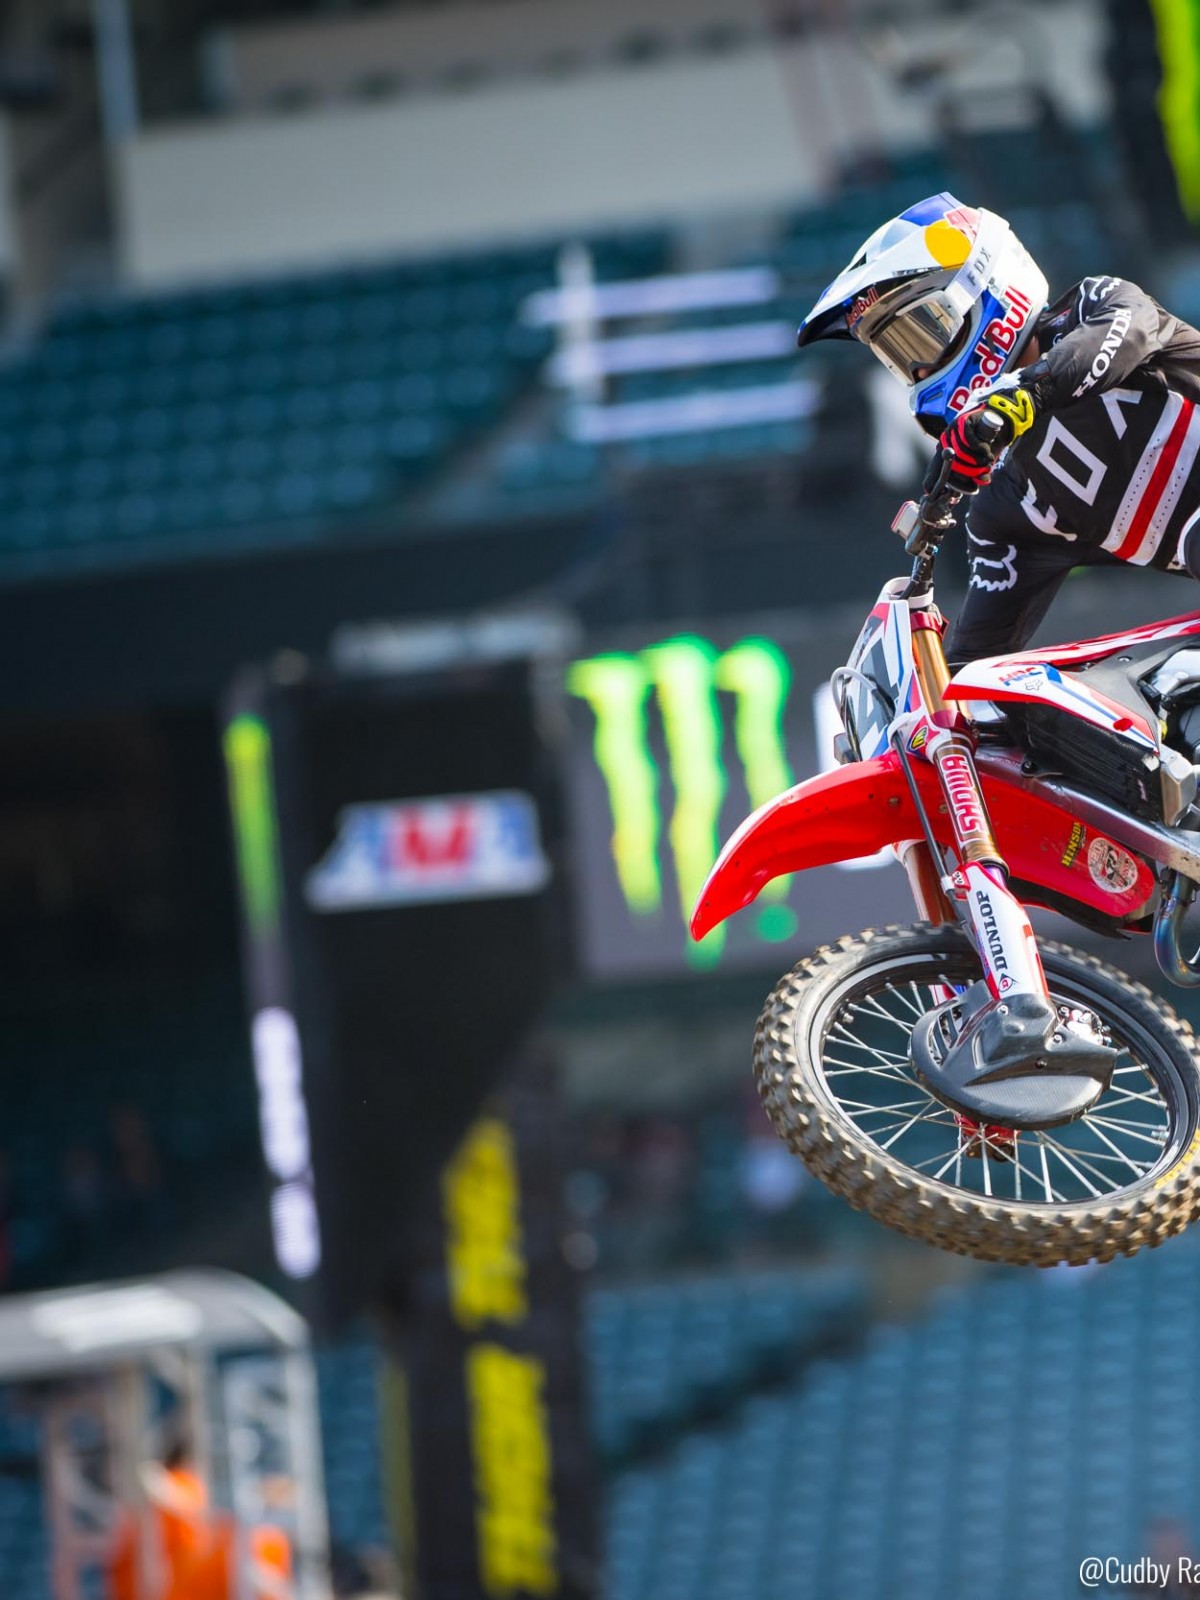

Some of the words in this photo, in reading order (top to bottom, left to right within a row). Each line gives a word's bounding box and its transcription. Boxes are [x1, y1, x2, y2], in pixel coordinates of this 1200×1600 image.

[1072, 309, 1132, 398] HONDA
[940, 755, 984, 836] SHOWA
[975, 889, 1008, 972] DUNLOP
